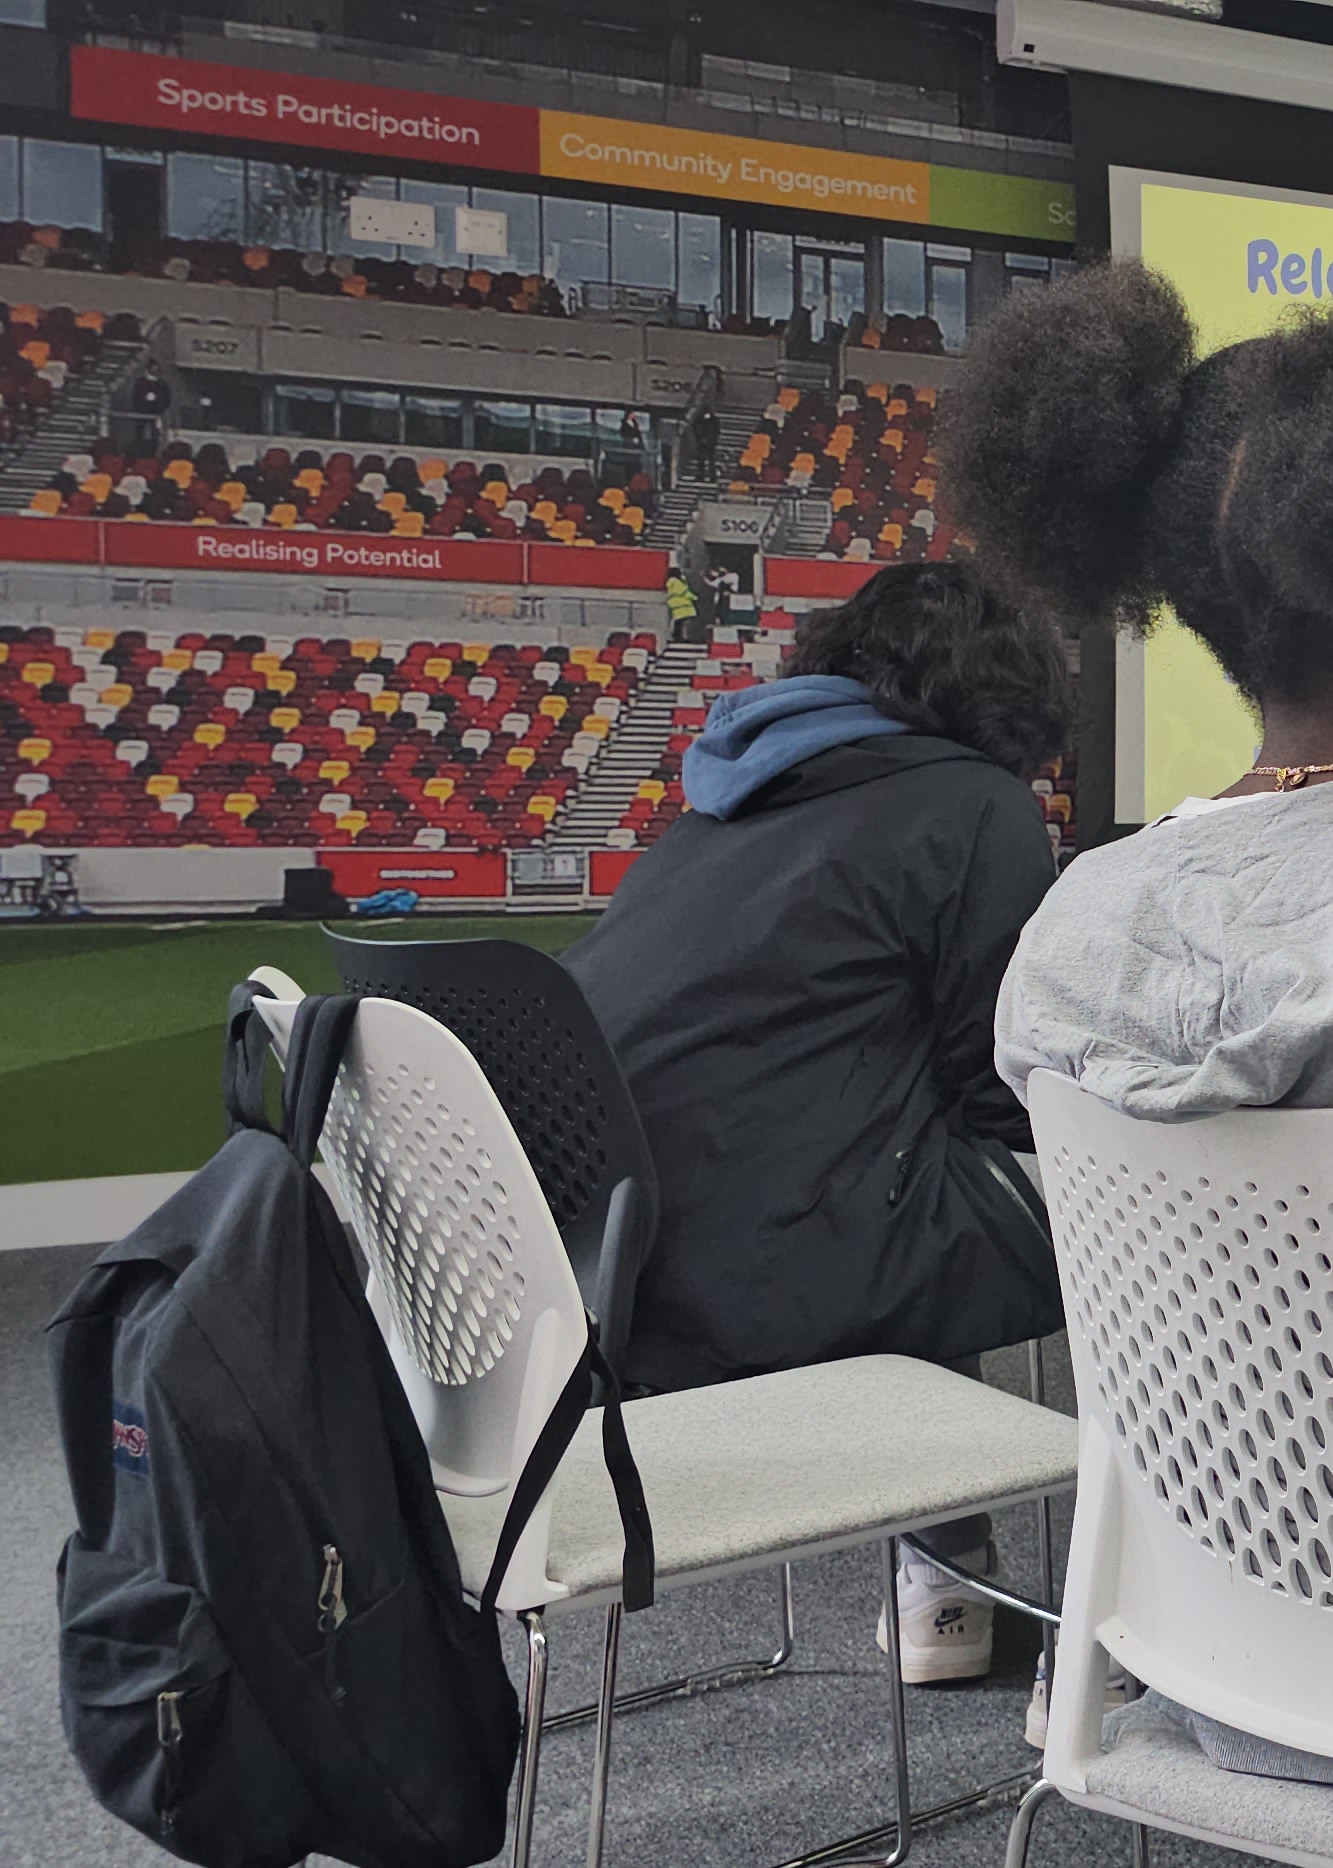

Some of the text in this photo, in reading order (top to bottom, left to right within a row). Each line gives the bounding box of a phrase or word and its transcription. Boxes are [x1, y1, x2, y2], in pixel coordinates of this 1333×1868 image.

[158, 78, 480, 146] Sports Participation
[559, 133, 917, 206] Community Engagement
[196, 535, 443, 569] Realising Potential
